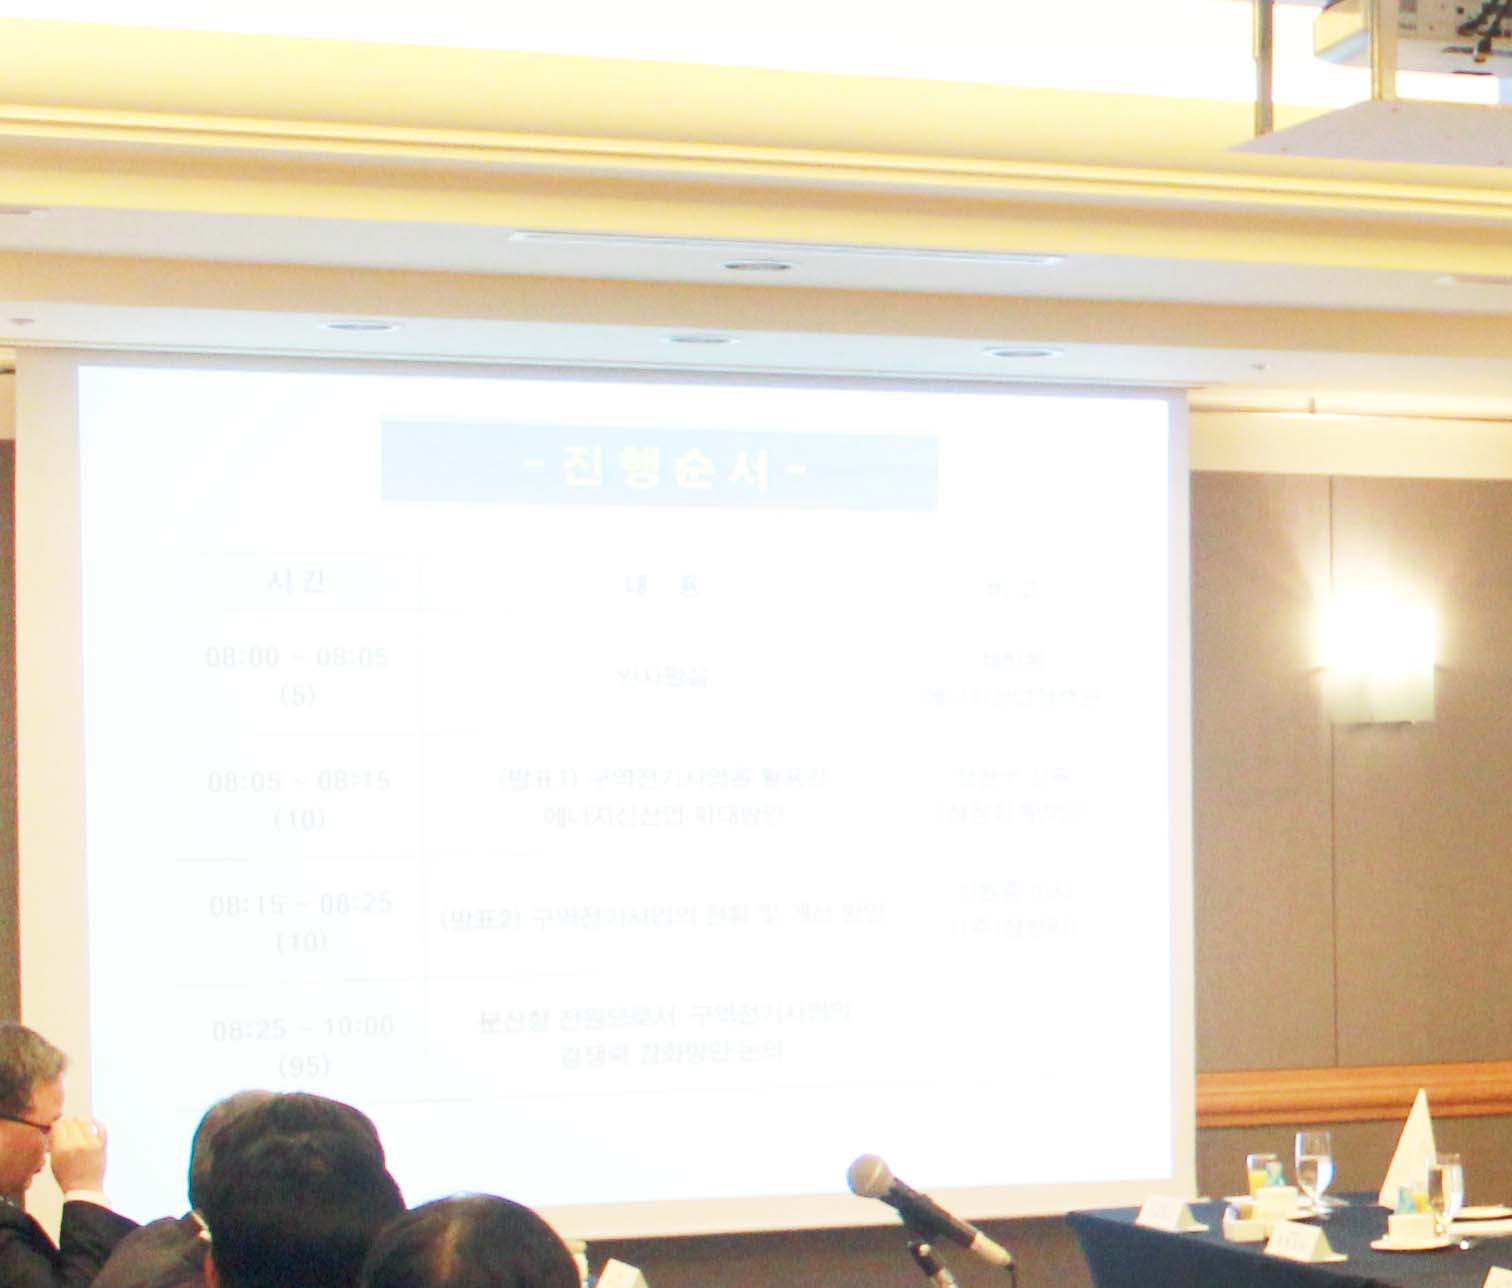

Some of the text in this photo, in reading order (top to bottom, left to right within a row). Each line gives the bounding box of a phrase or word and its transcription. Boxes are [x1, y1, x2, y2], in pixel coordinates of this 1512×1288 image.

[562, 444, 770, 492] 진행순서
[265, 567, 331, 595] 시간
[204, 645, 281, 669] 08:00
[316, 645, 389, 670] 08:05
[279, 681, 317, 708] (5)
[206, 769, 282, 794] 08:05
[316, 768, 392, 793] 08:15
[273, 807, 328, 833] (10)
[209, 892, 285, 920] 08:15
[319, 889, 394, 917] 08:25
[275, 928, 329, 956] (10)
[210, 1017, 288, 1043] 08:25
[323, 1013, 396, 1038] 10:00
[277, 1050, 332, 1081] (95)
